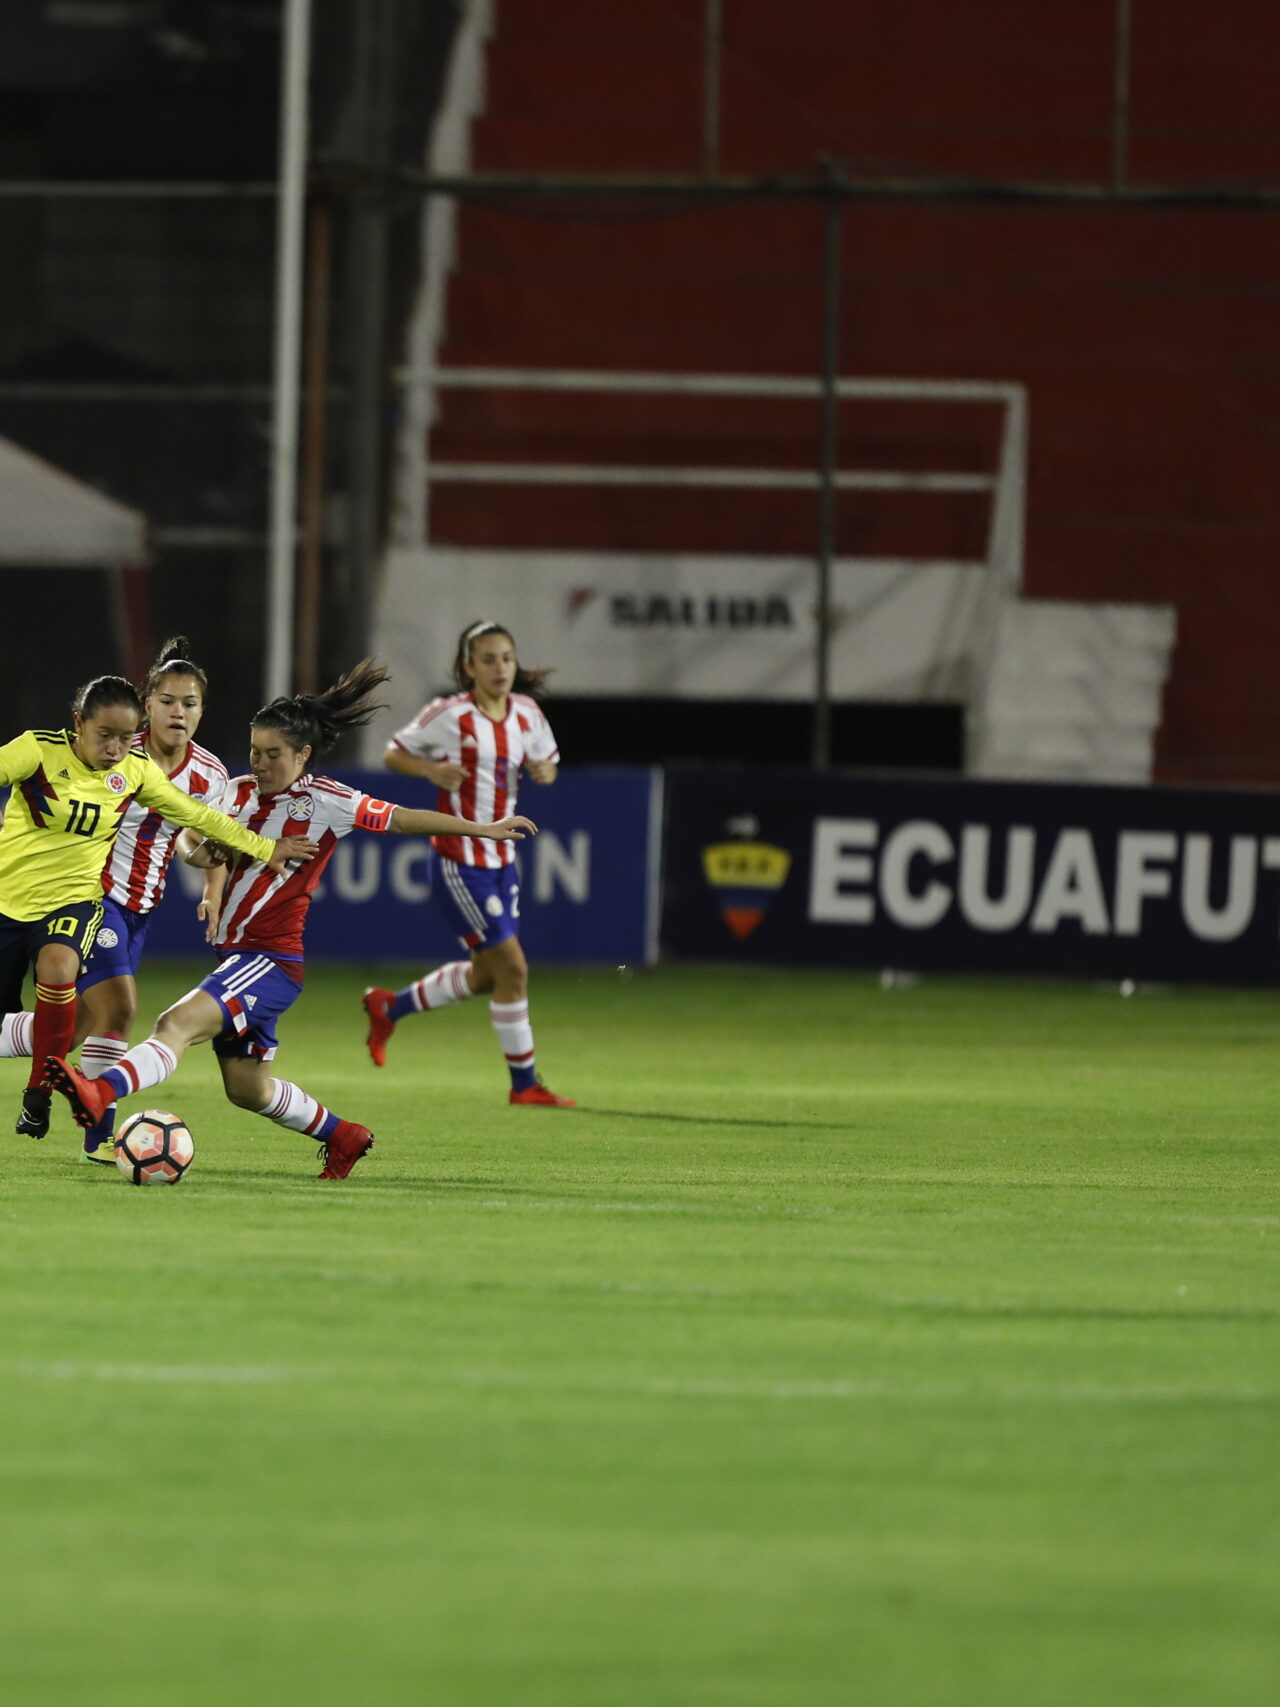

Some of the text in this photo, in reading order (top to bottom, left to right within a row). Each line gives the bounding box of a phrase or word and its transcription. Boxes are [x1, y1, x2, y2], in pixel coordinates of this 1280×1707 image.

[609, 593, 793, 630] SALIDA
[64, 798, 102, 838] 10
[46, 916, 79, 938] 10
